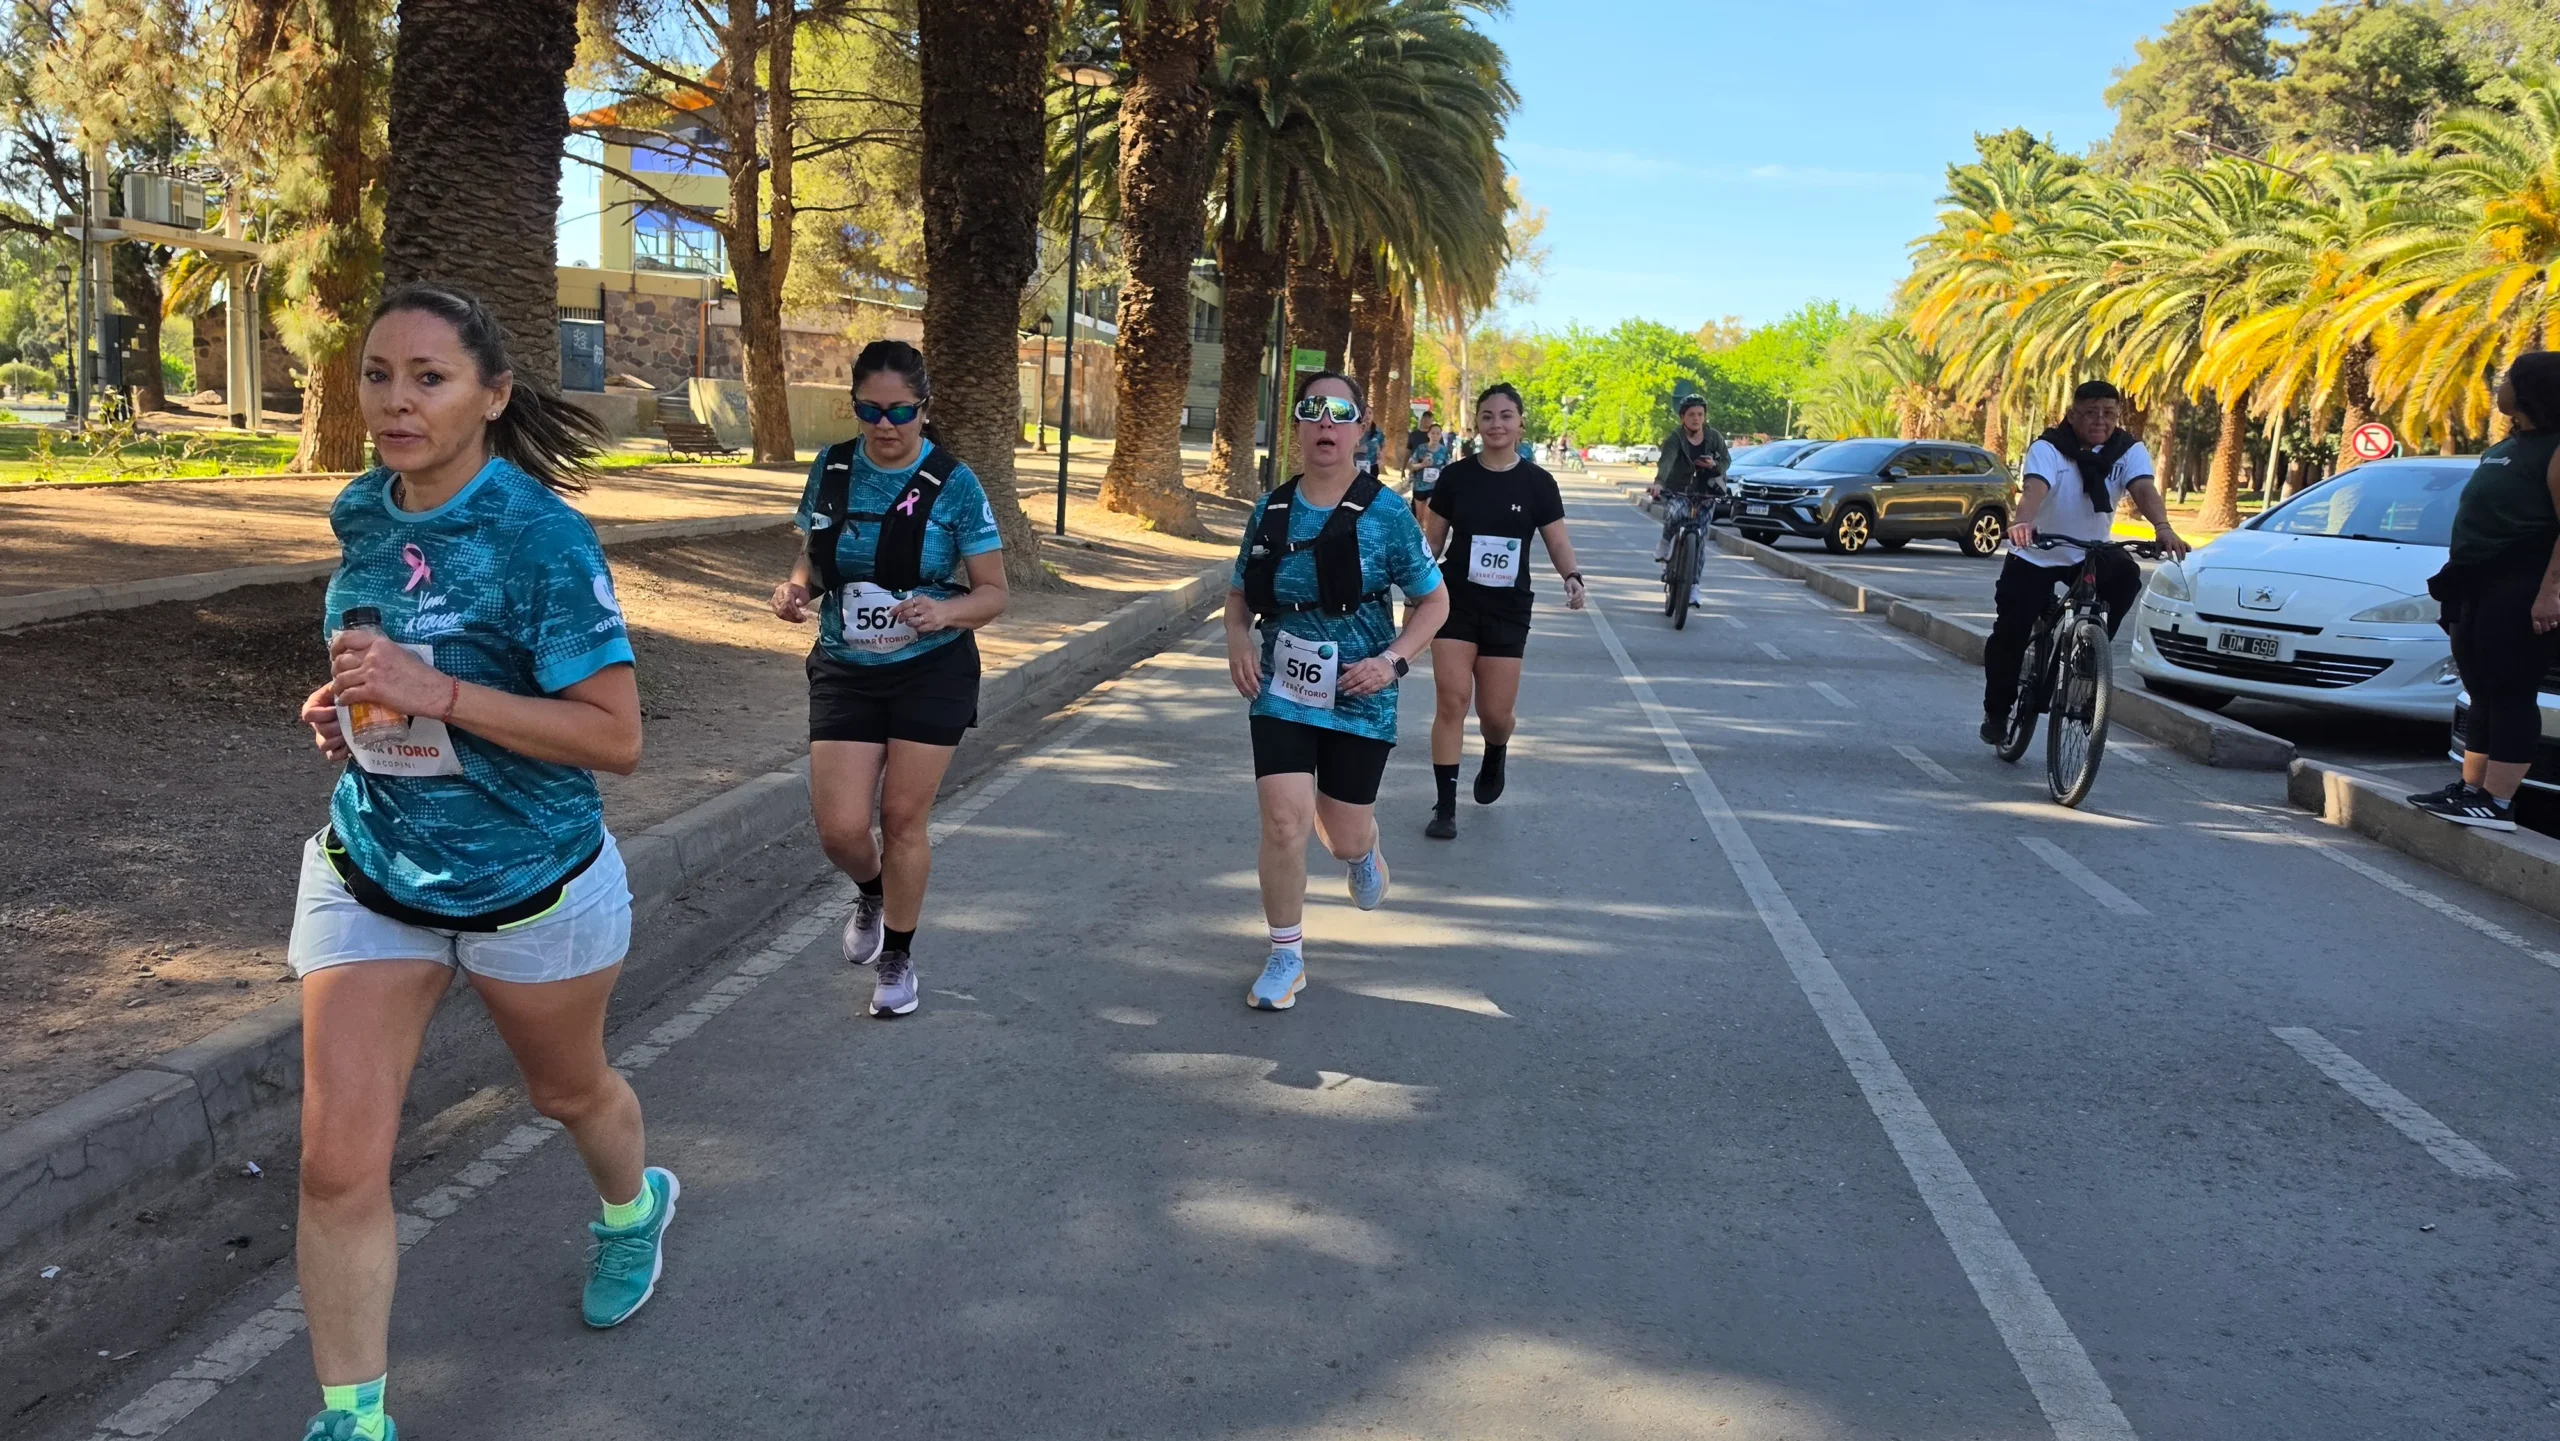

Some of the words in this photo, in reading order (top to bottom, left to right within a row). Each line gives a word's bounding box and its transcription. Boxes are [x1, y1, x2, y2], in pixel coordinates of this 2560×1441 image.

[1480, 552, 1509, 570] 616
[856, 606, 898, 631] 567
[2220, 634, 2246, 651] LDM
[2251, 639, 2277, 656] 698
[1286, 657, 1322, 684] 516
[1281, 680, 1328, 699] TERRITORIO
